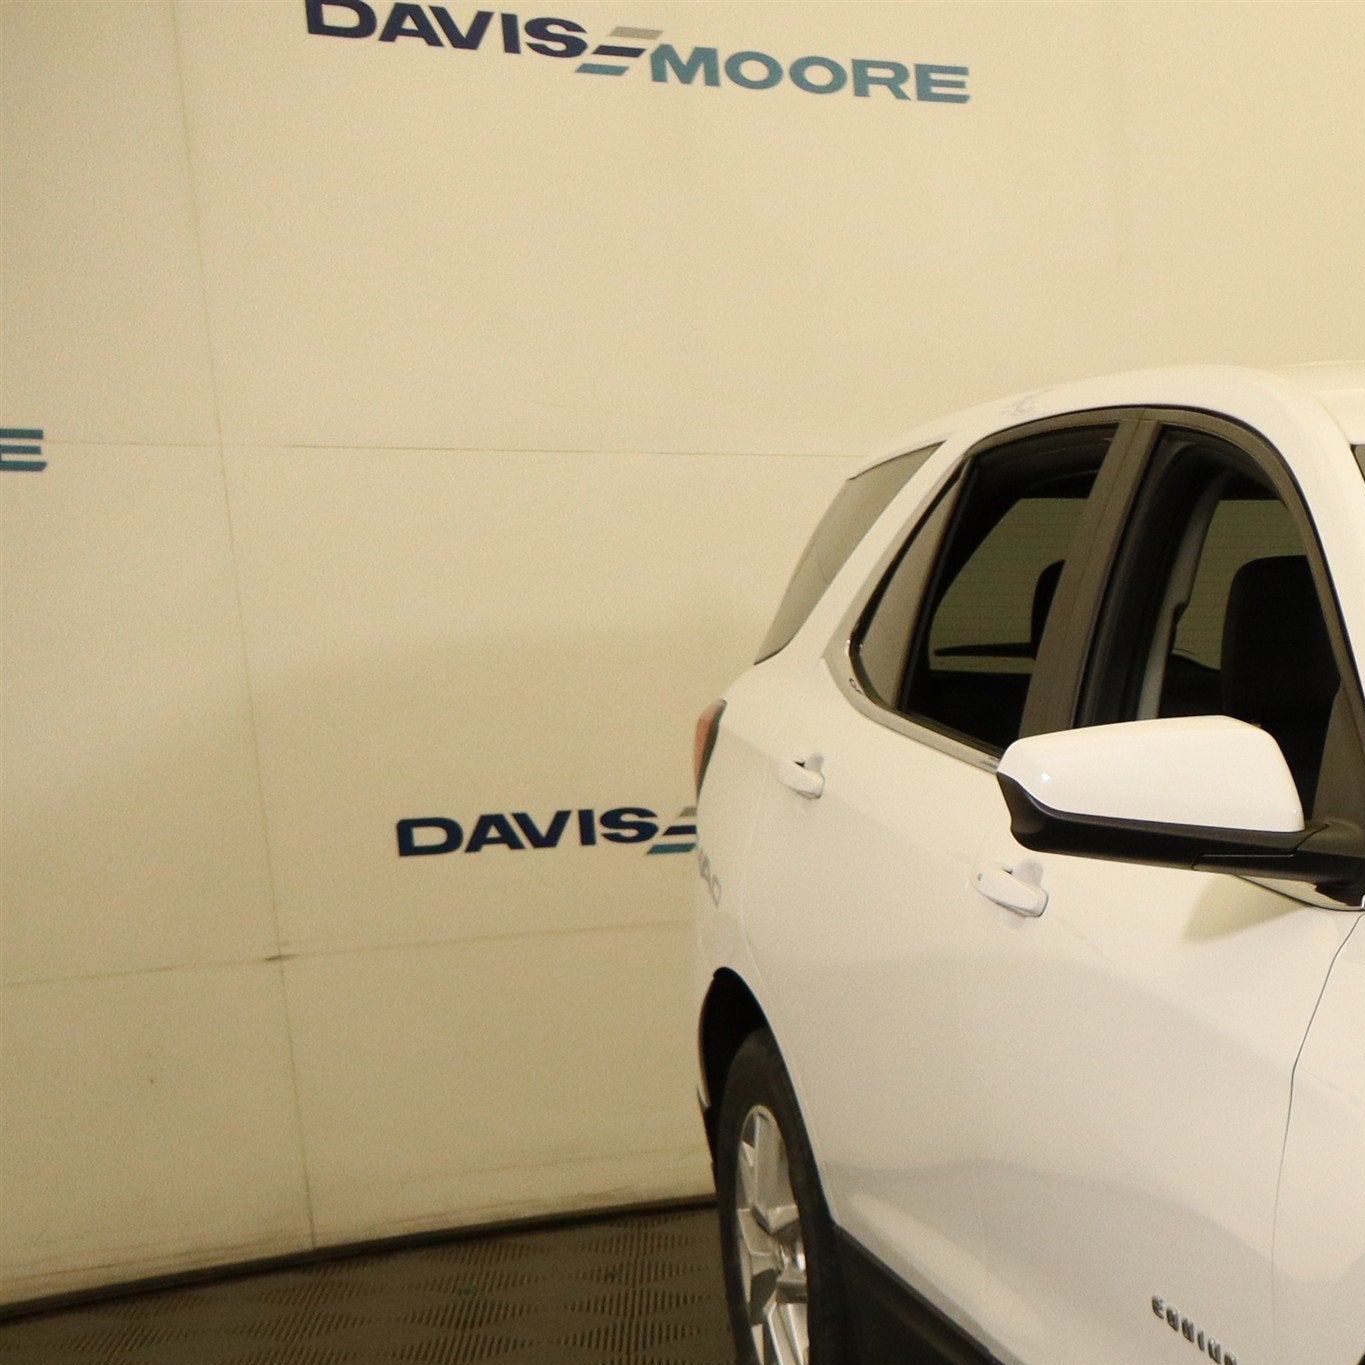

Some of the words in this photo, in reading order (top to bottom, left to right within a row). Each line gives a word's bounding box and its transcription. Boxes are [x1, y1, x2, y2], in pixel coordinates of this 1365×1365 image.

[306, 0, 588, 58] DAVIS
[650, 43, 970, 103] MOORE
[396, 806, 659, 857] DAVIS
